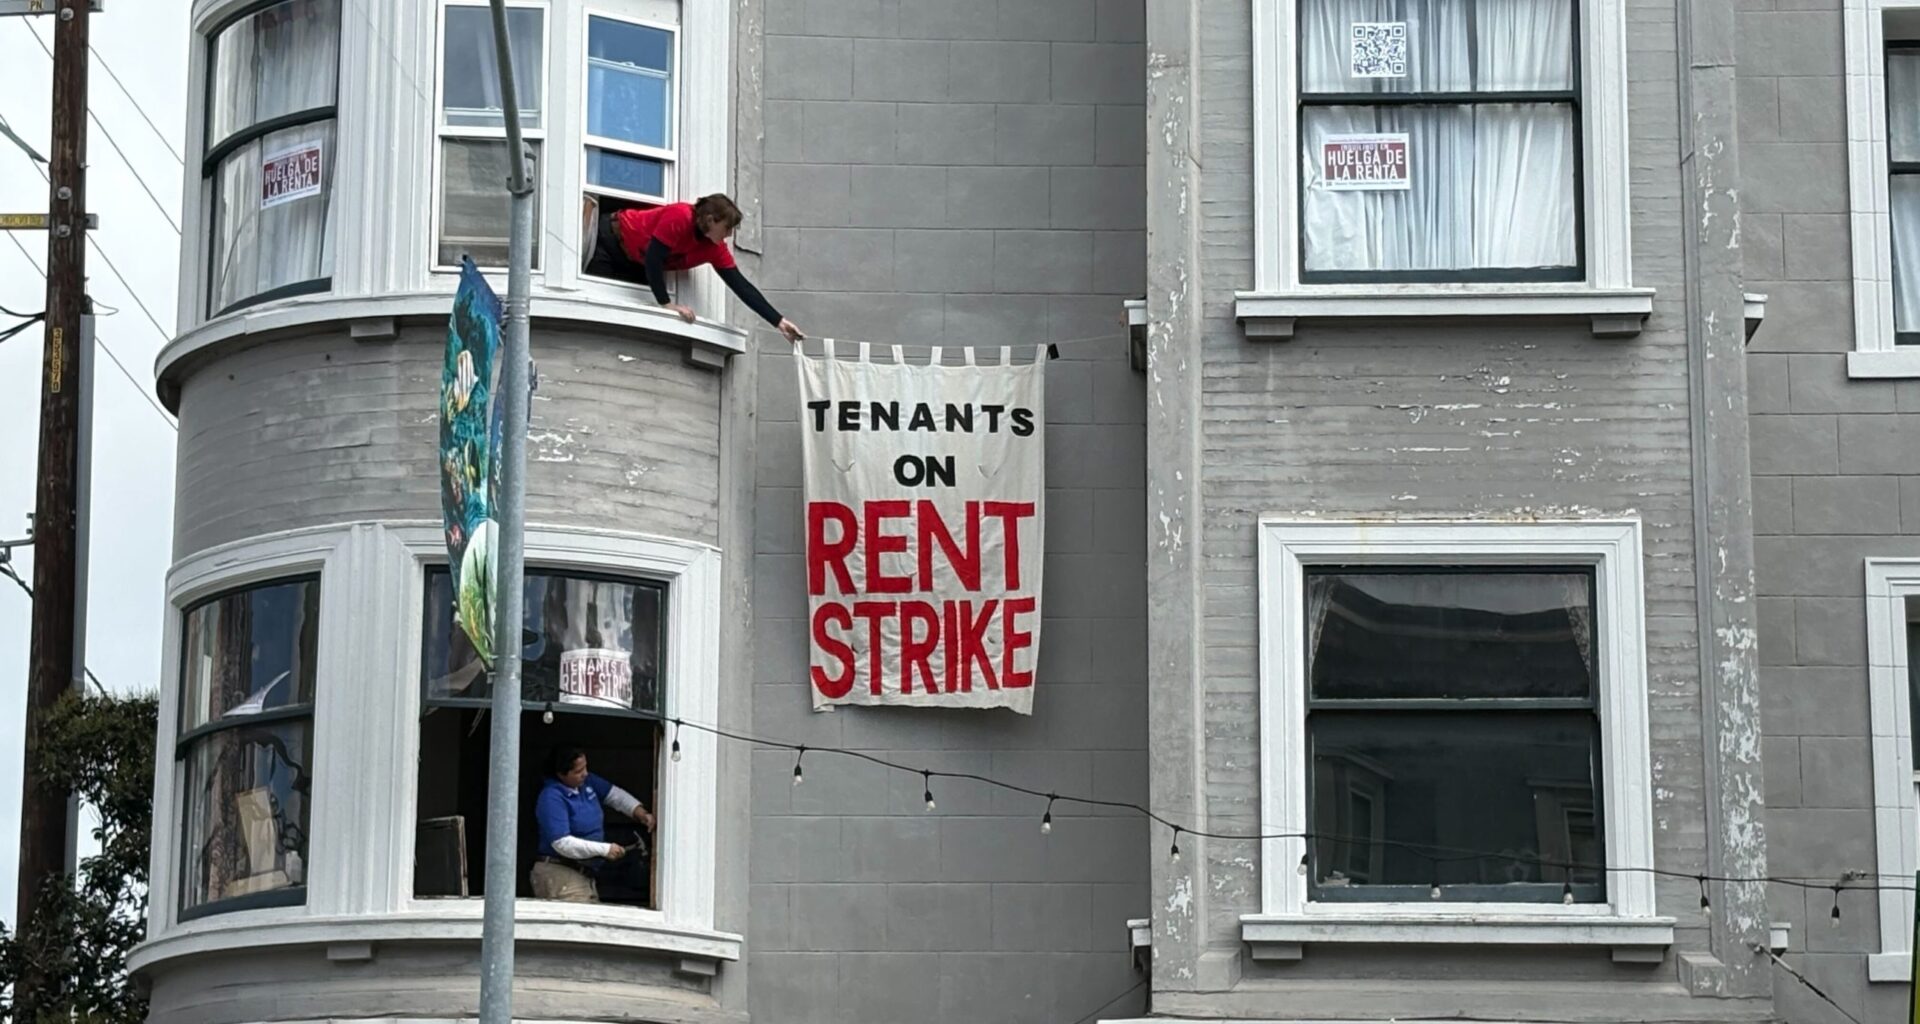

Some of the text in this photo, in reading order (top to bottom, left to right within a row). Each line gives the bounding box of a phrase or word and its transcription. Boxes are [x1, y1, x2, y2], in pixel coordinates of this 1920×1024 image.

[265, 160, 301, 186] HUELGA
[305, 156, 318, 173] DE
[1327, 149, 1404, 166] HUELGA DE
[268, 181, 279, 198] LA
[282, 172, 313, 193] RENTA
[1334, 164, 1399, 181] LA RENTA
[807, 400, 1035, 437] TENANTS
[893, 454, 956, 487] ON
[808, 500, 1035, 596] RENT
[811, 597, 1036, 699] STRIKE
[561, 657, 617, 675] TENANTS
[561, 672, 593, 696] RENT
